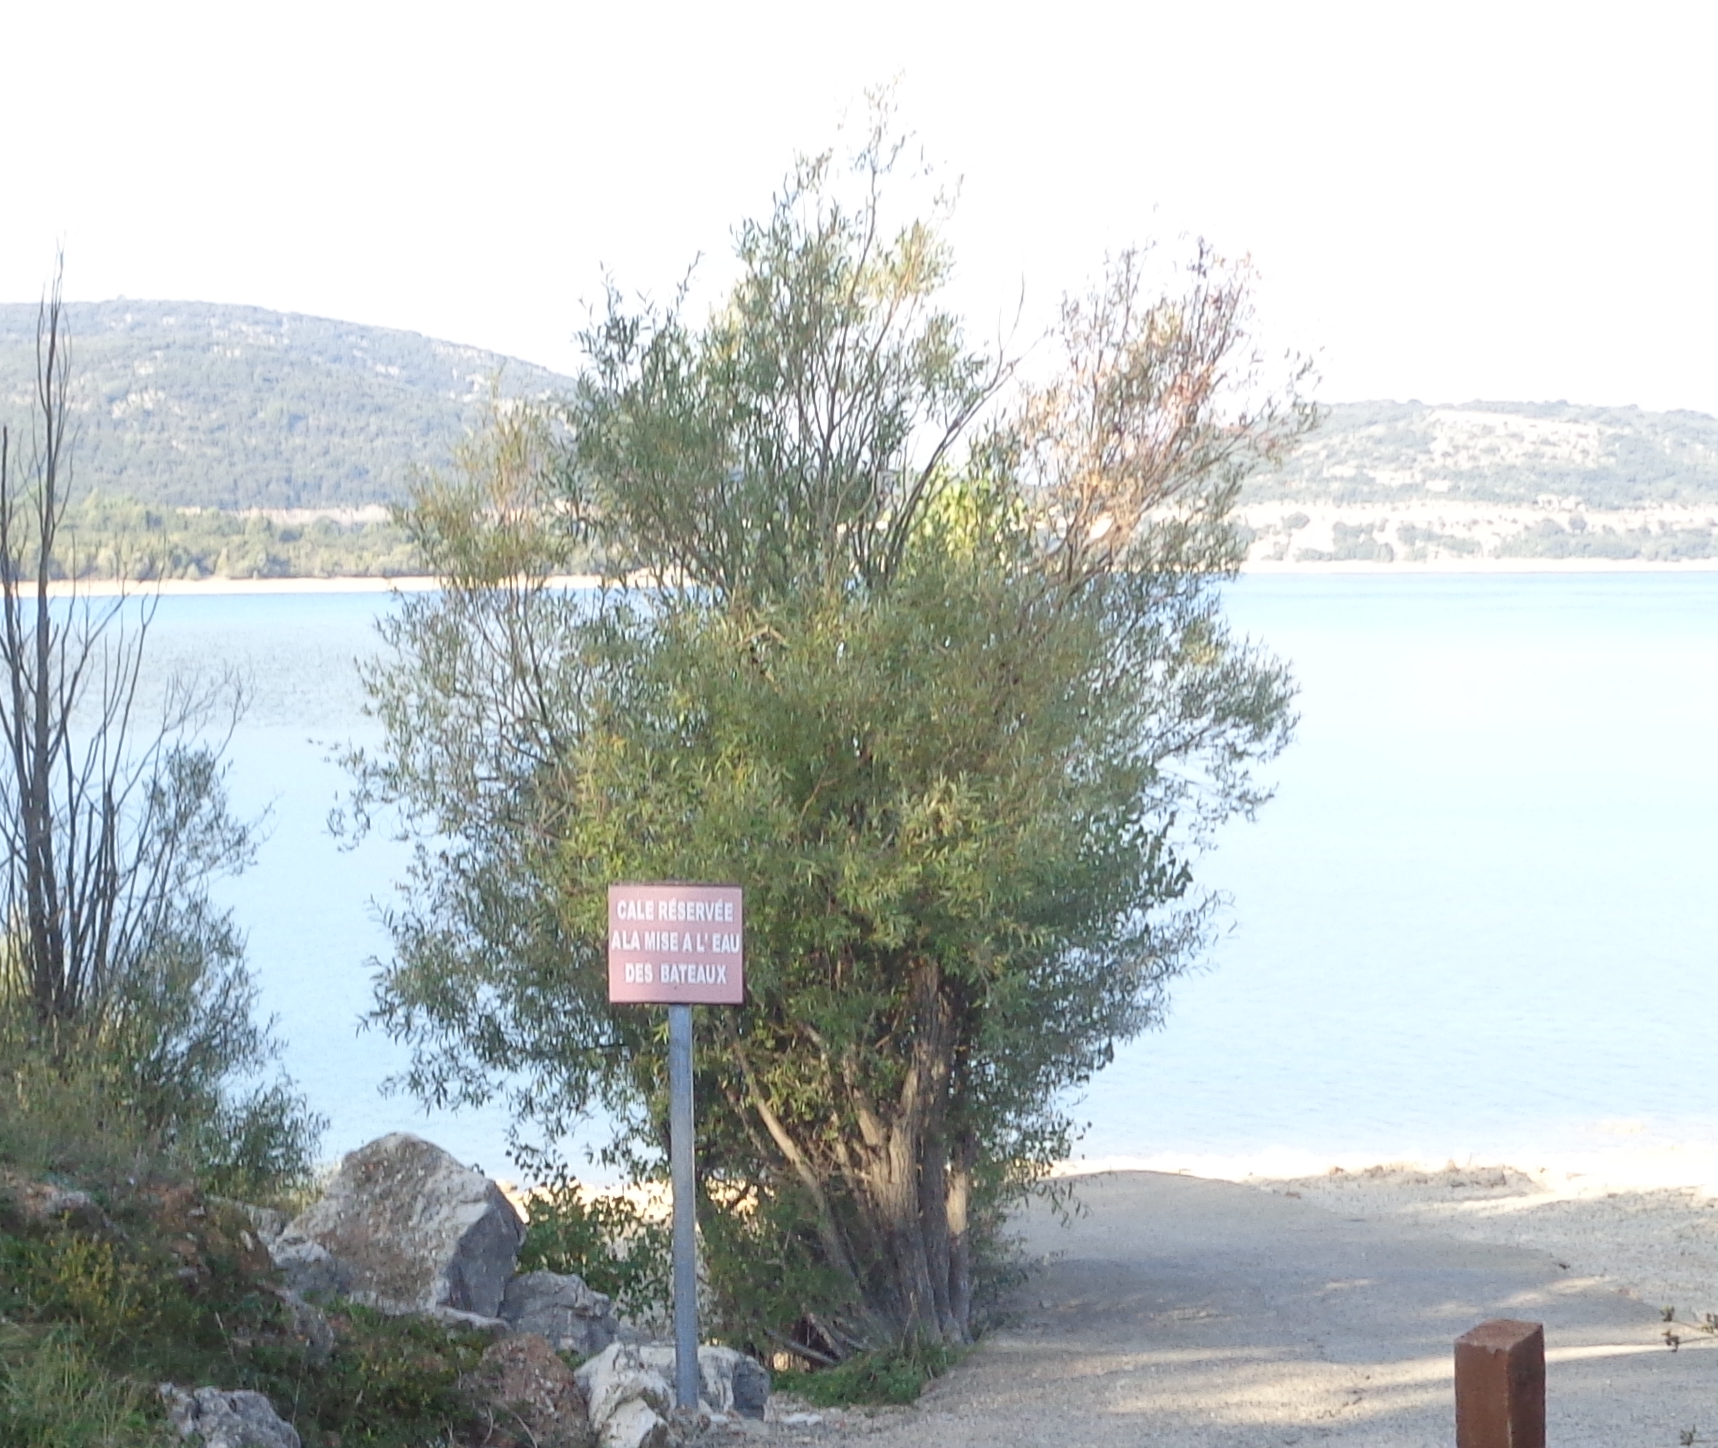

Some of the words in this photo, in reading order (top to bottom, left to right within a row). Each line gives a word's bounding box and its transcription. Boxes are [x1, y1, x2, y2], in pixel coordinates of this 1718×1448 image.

[617, 900, 654, 920] CALE
[658, 897, 733, 922] RÉSERVÉE
[644, 931, 678, 952] MISE
[682, 932, 693, 953] A
[625, 963, 653, 984] DES
[660, 963, 727, 985] BATEAUX
